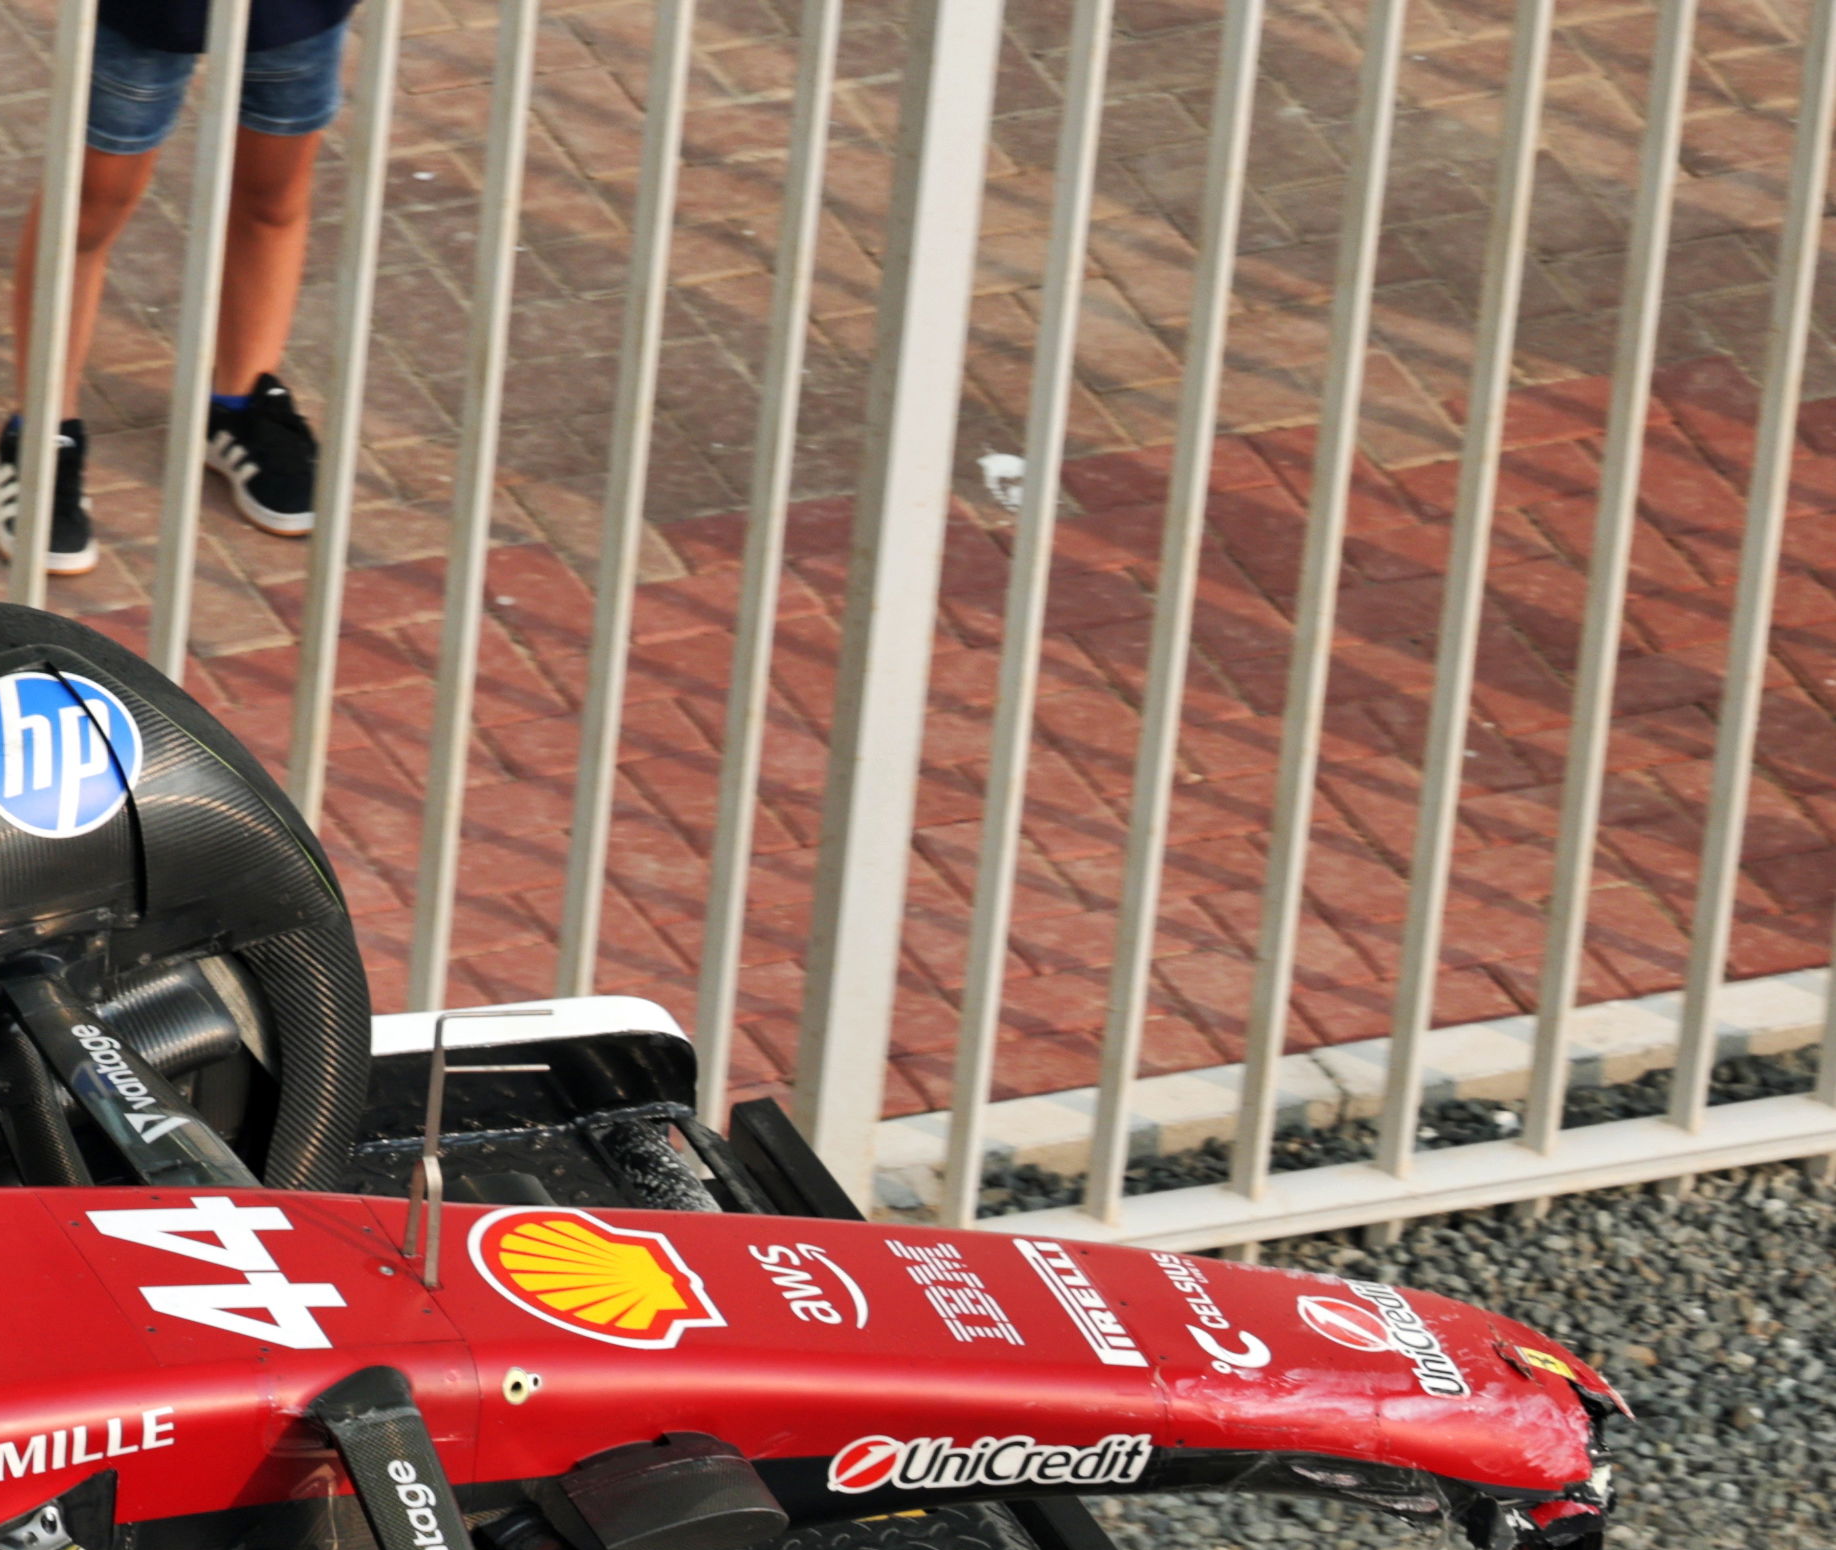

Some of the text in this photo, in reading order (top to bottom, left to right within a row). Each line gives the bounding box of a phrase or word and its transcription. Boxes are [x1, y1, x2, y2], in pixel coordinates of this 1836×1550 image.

[0, 678, 111, 832] hp
[71, 1024, 156, 1110] vantage
[85, 1195, 347, 1349] 44
[748, 1243, 842, 1325] aws
[884, 1239, 1026, 1346] IBM
[1012, 1238, 1150, 1368] PIRELLI
[1150, 1252, 1230, 1329] CELSIUS
[902, 1436, 1149, 1487] UniCredit
